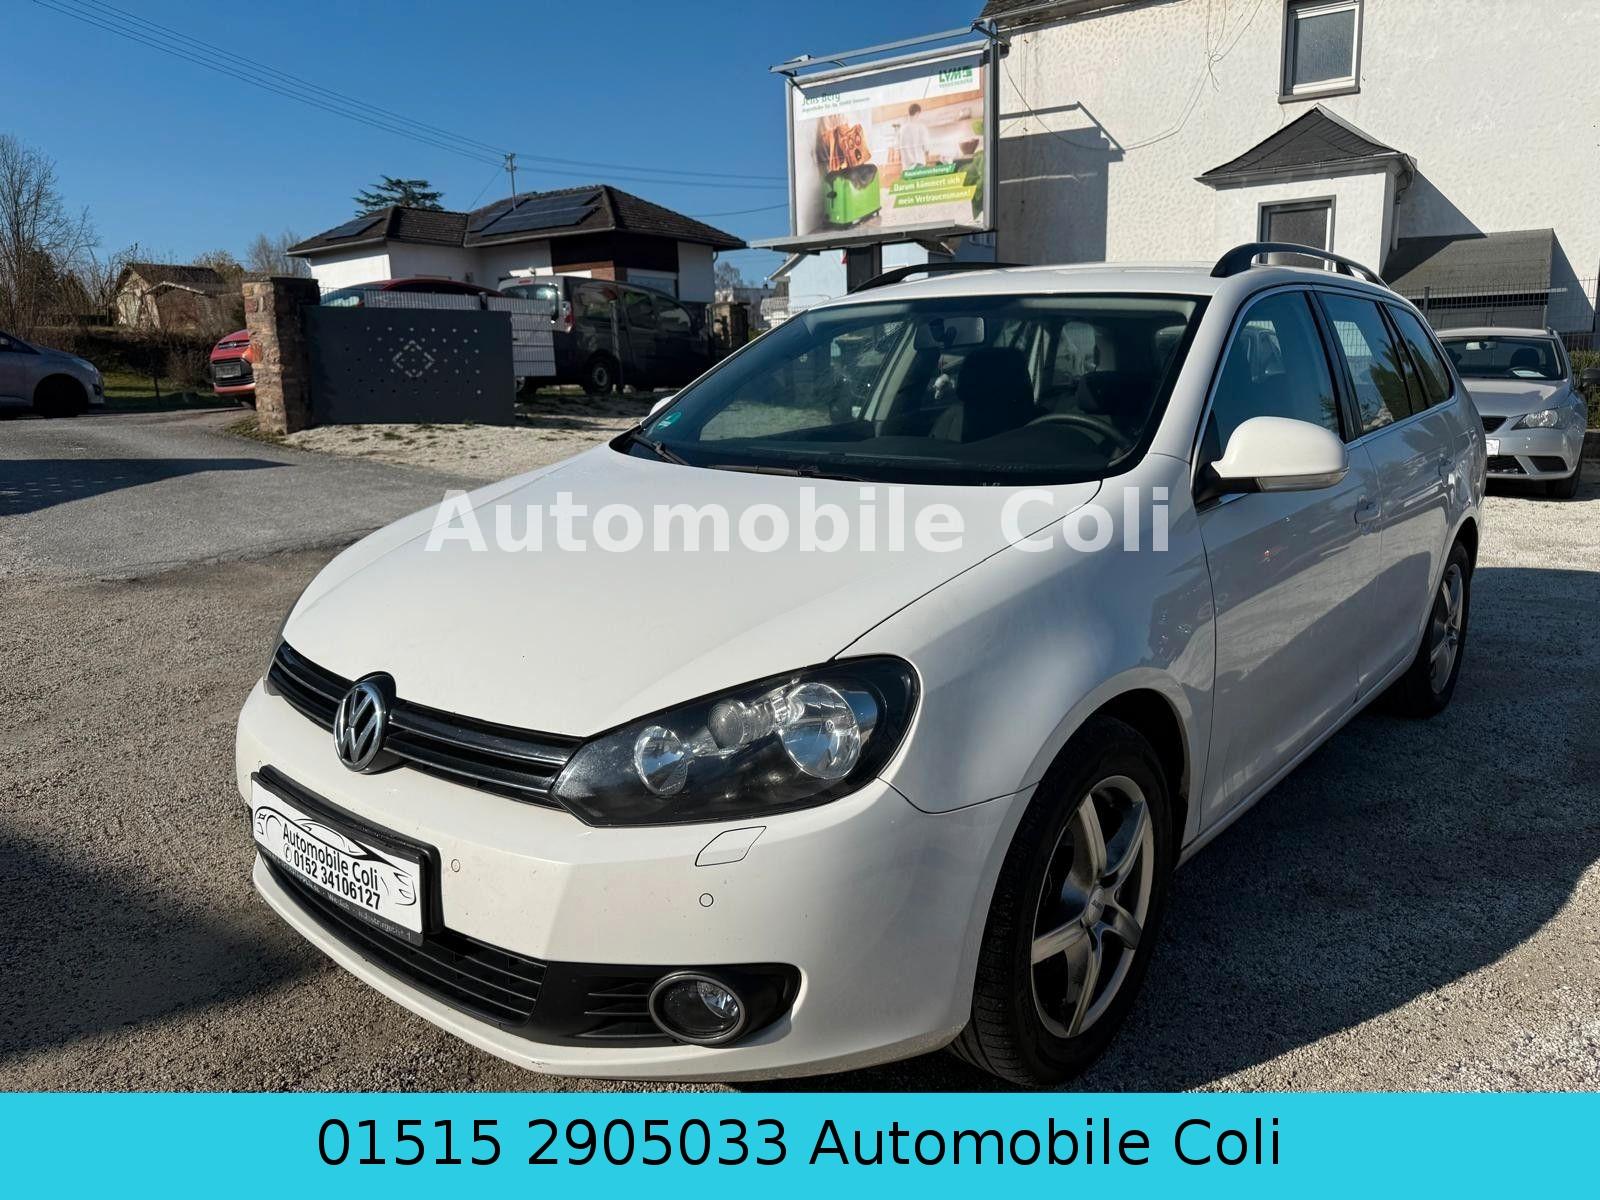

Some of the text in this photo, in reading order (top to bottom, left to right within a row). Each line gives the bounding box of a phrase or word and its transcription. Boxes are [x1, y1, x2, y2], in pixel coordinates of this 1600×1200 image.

[282, 823, 349, 876] Automobile
[352, 861, 379, 891] Coli
[293, 850, 318, 879] 0152
[321, 871, 381, 910] 34106127
